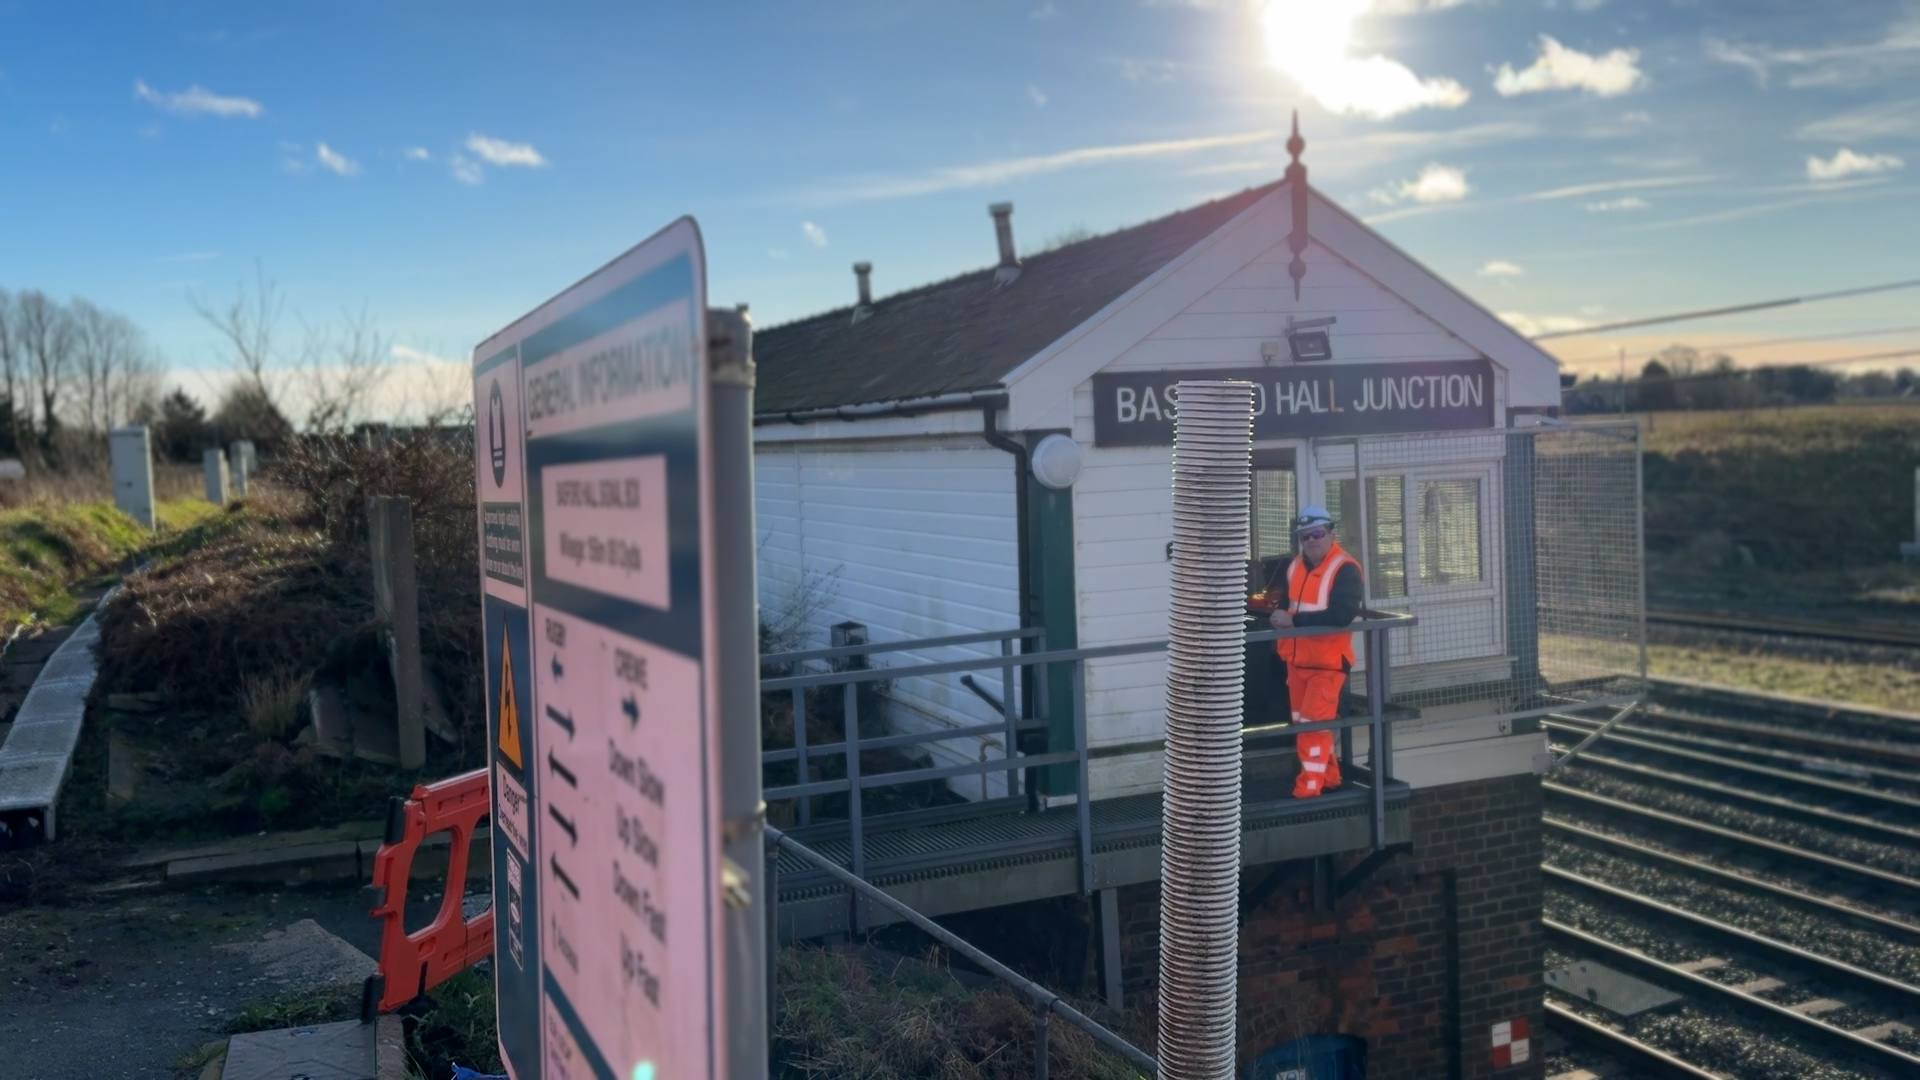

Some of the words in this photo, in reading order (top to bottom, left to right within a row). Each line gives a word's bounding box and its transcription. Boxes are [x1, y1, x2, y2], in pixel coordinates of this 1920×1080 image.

[528, 366, 577, 420] GENERAL
[579, 326, 690, 405] INFORMATION
[1116, 382, 1267, 423] BASD
[1275, 379, 1344, 416] HALL
[1353, 373, 1483, 412] JUNCTION
[502, 774, 520, 815] Danger
[607, 735, 635, 788] Down
[637, 755, 666, 810] Slow
[616, 802, 631, 852] Up
[632, 815, 660, 870] Slow
[612, 858, 640, 918] Down
[642, 888, 668, 948] Fast
[620, 929, 635, 993] Up
[637, 950, 662, 1013] Fast
